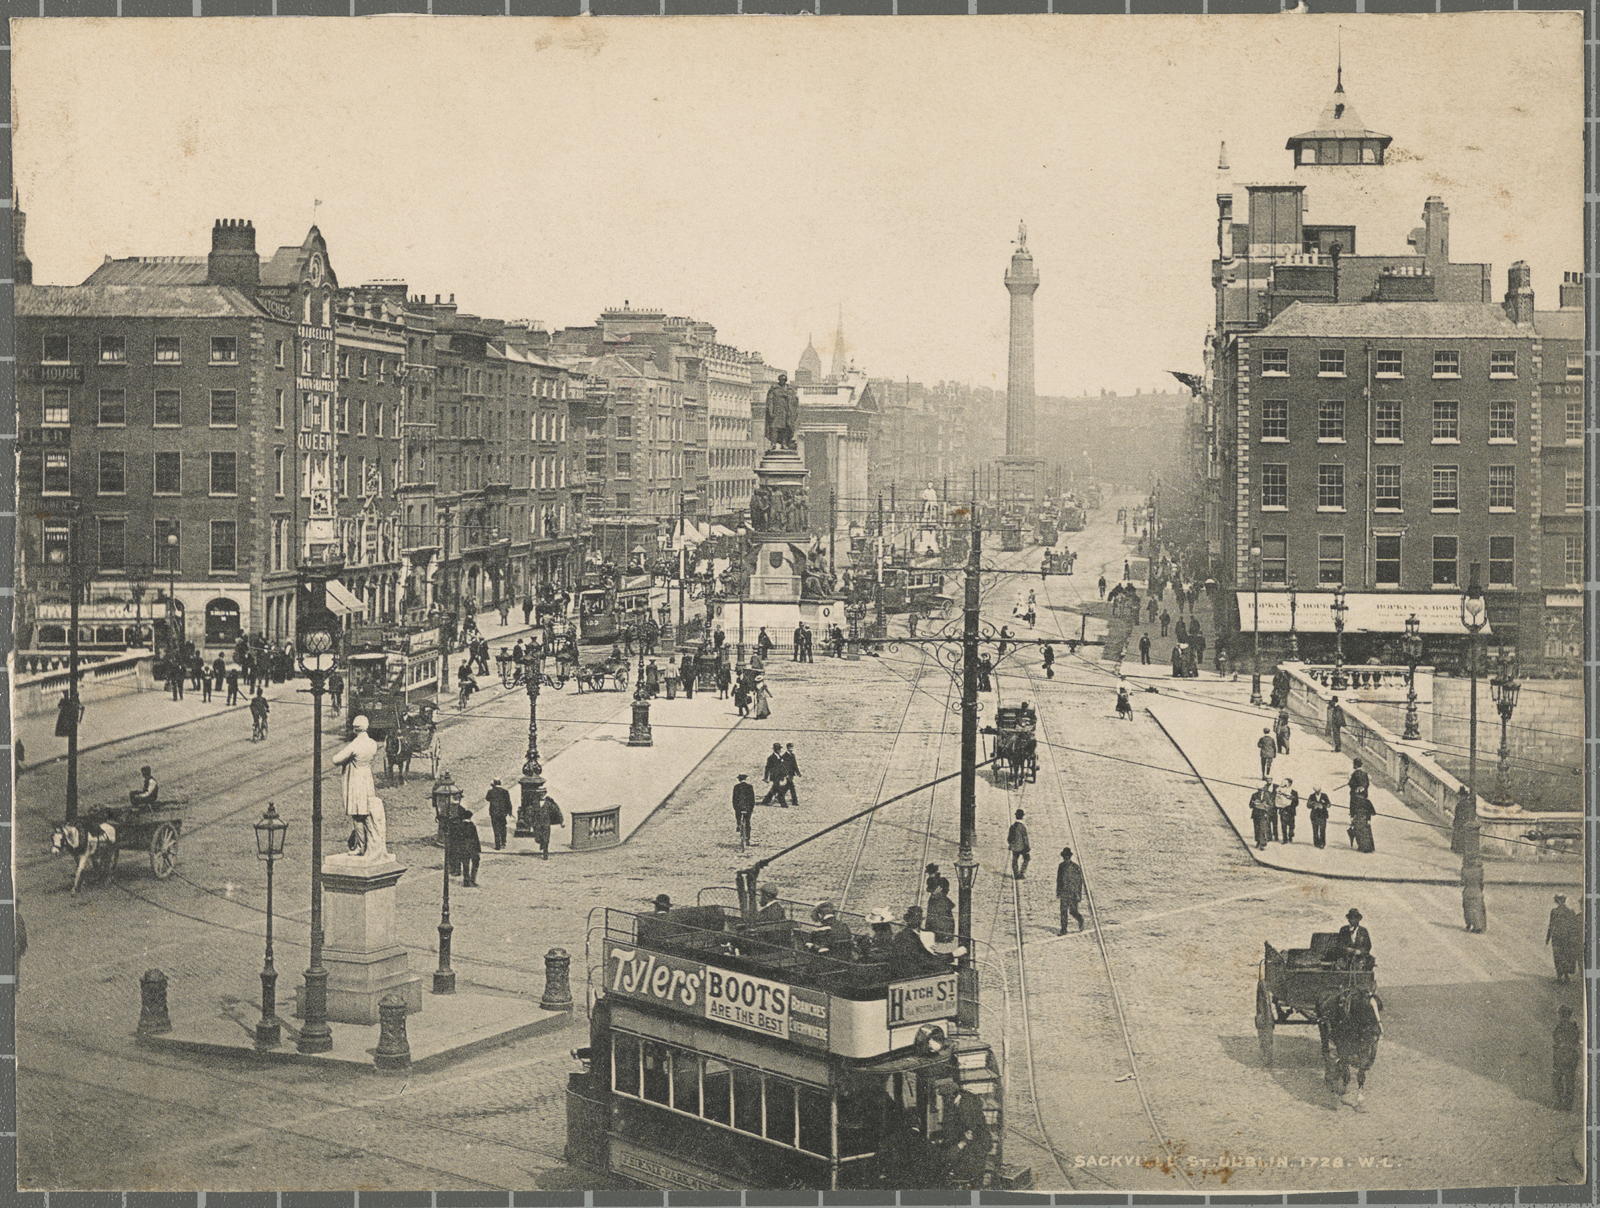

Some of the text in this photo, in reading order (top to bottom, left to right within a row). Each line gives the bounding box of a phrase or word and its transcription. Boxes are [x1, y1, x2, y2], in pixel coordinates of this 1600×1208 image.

[297, 433, 332, 451] QUEEN
[611, 948, 785, 1016] Tylers' BOOTS
[711, 1000, 784, 1033] ARE THE BEST
[890, 986, 933, 1021] HATCH
